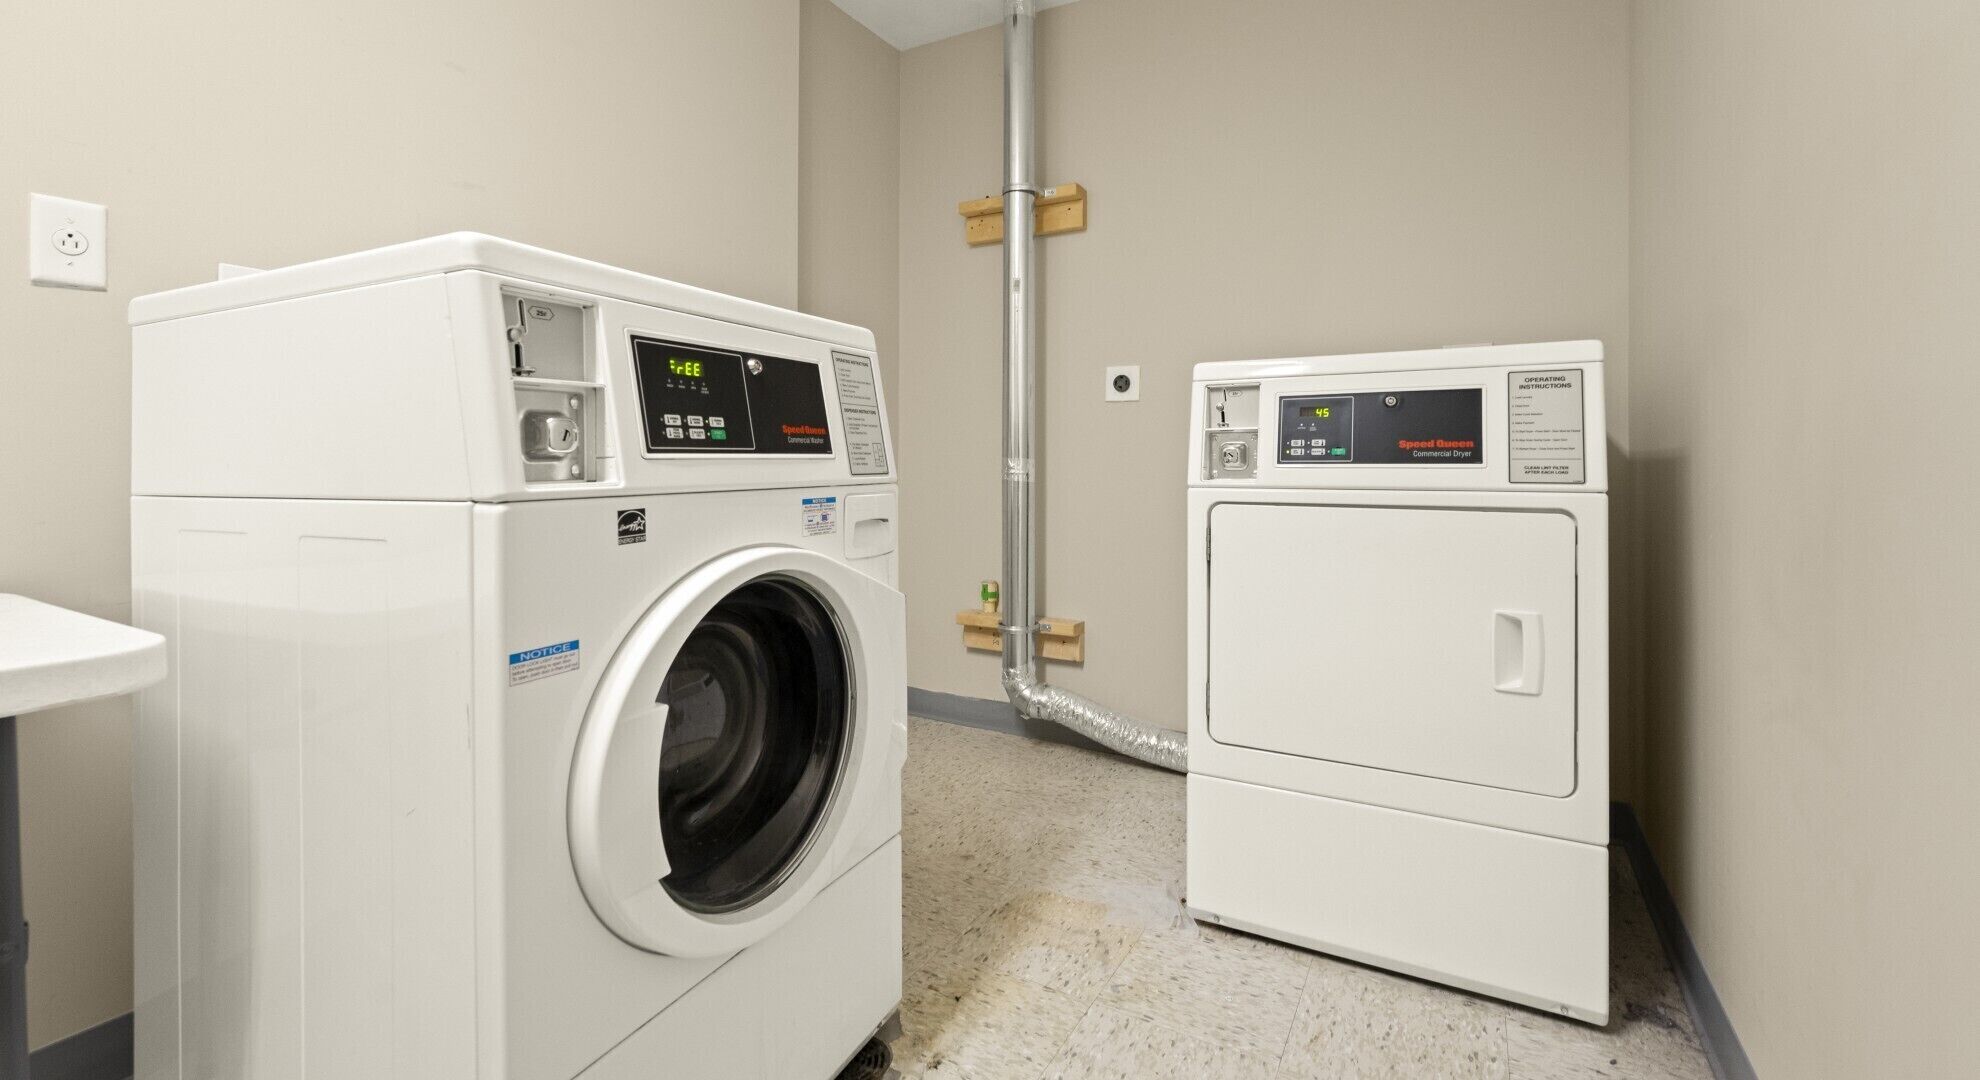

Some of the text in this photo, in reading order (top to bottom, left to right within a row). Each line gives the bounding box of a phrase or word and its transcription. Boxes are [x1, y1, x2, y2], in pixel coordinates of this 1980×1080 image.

[1524, 375, 1566, 383] OPERATING
[1518, 382, 1572, 390] INSTRUCTIONS
[1315, 407, 1330, 418] 45
[783, 424, 827, 435] Speed Queen
[1398, 439, 1474, 450] Speed Queen
[1453, 450, 1472, 459] Dryer
[520, 643, 572, 662] NOTICE
